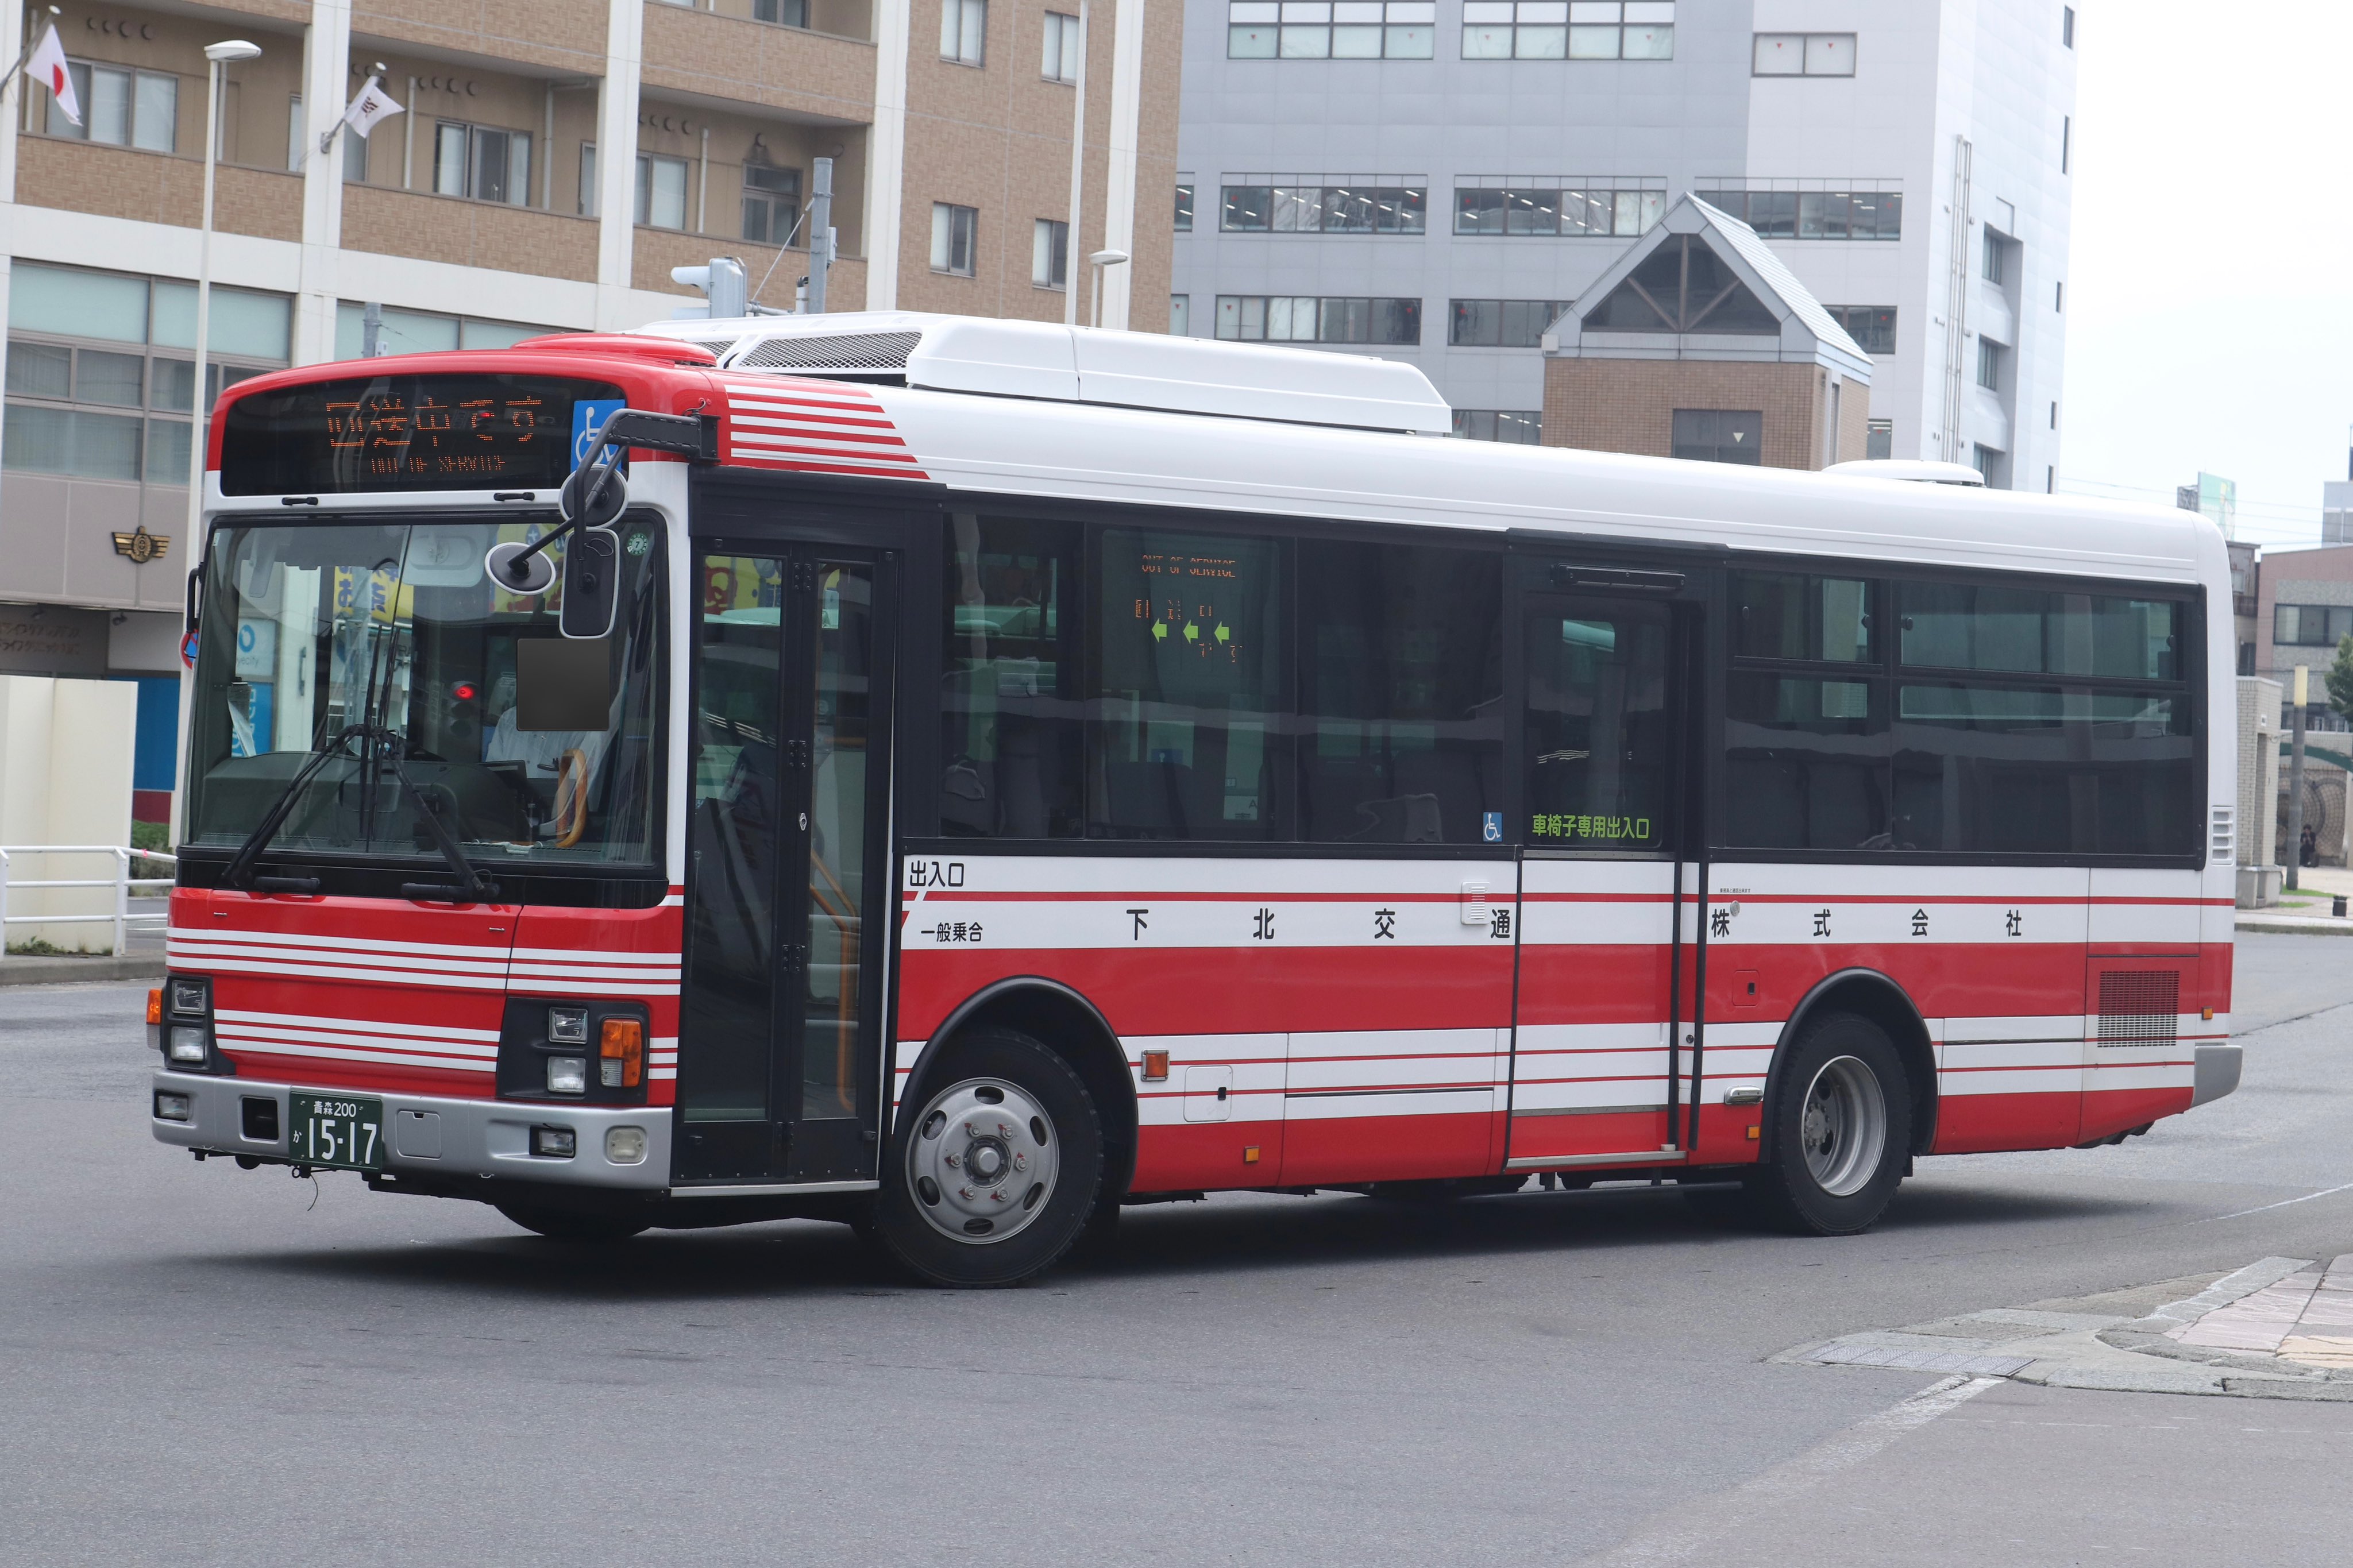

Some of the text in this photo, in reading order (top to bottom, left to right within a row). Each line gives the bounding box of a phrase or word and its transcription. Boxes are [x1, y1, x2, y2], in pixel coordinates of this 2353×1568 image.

[1189, 558, 1236, 578] SERVICE
[1532, 813, 1650, 839] 車椅子専用出入口
[909, 860, 965, 887] 出入口
[920, 921, 983, 943] 一般乗合
[292, 1118, 377, 1164] か 15-17
